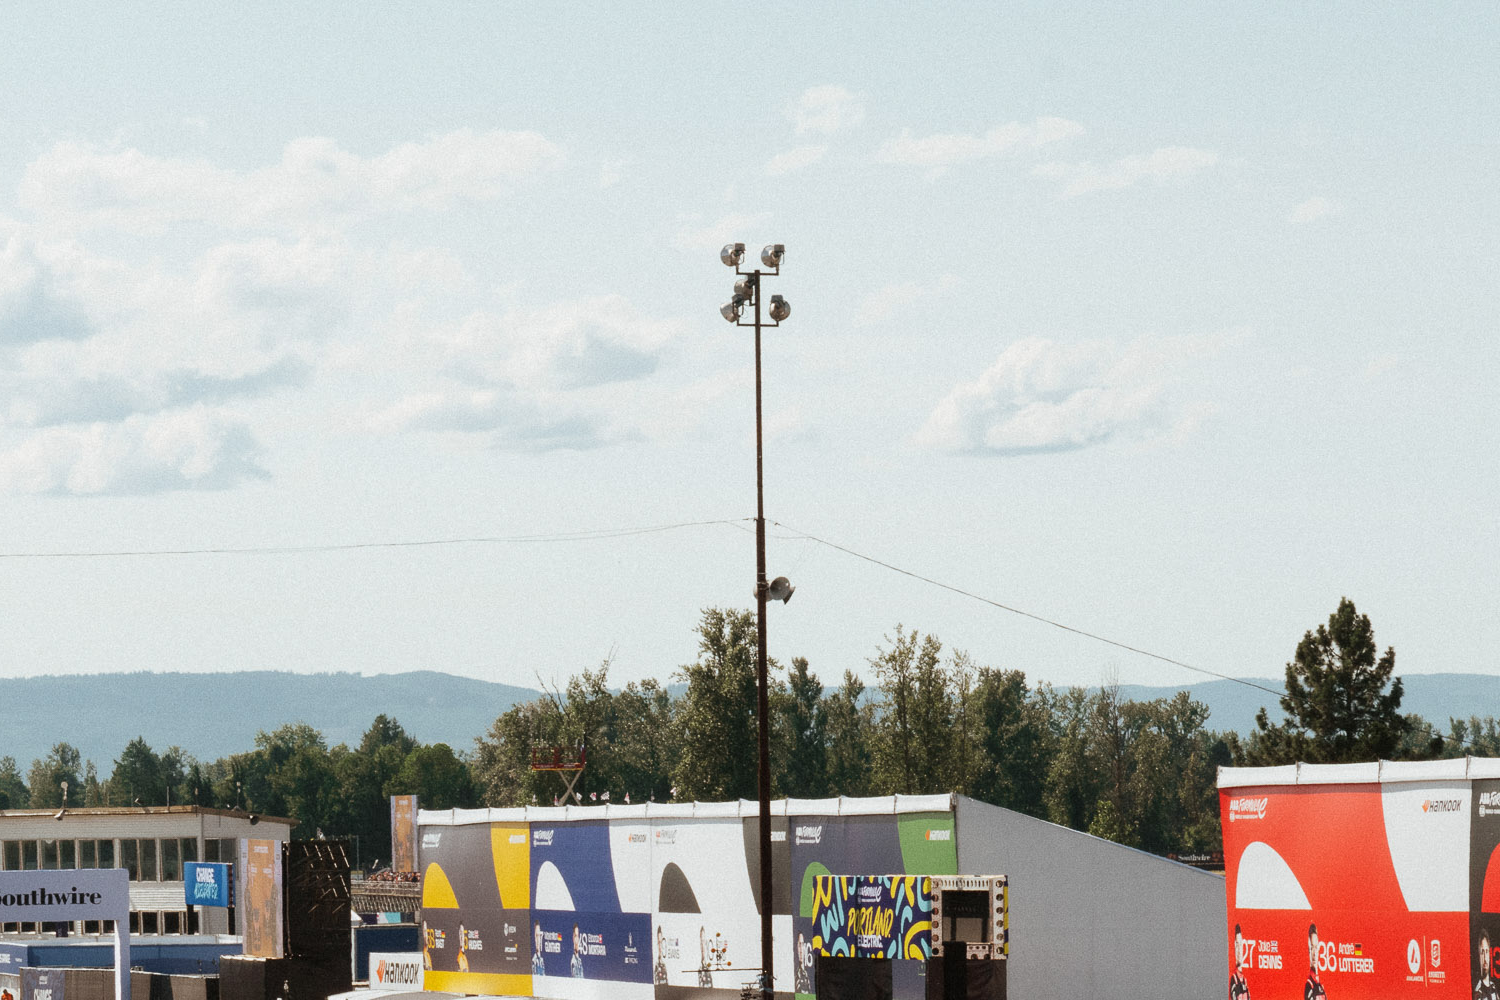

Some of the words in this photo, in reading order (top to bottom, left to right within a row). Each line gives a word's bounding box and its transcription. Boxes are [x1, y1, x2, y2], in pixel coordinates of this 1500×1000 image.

[1258, 955, 1282, 970] DENNIS
[1318, 941, 1337, 972] 36
[1339, 957, 1374, 973] LOTTERER
